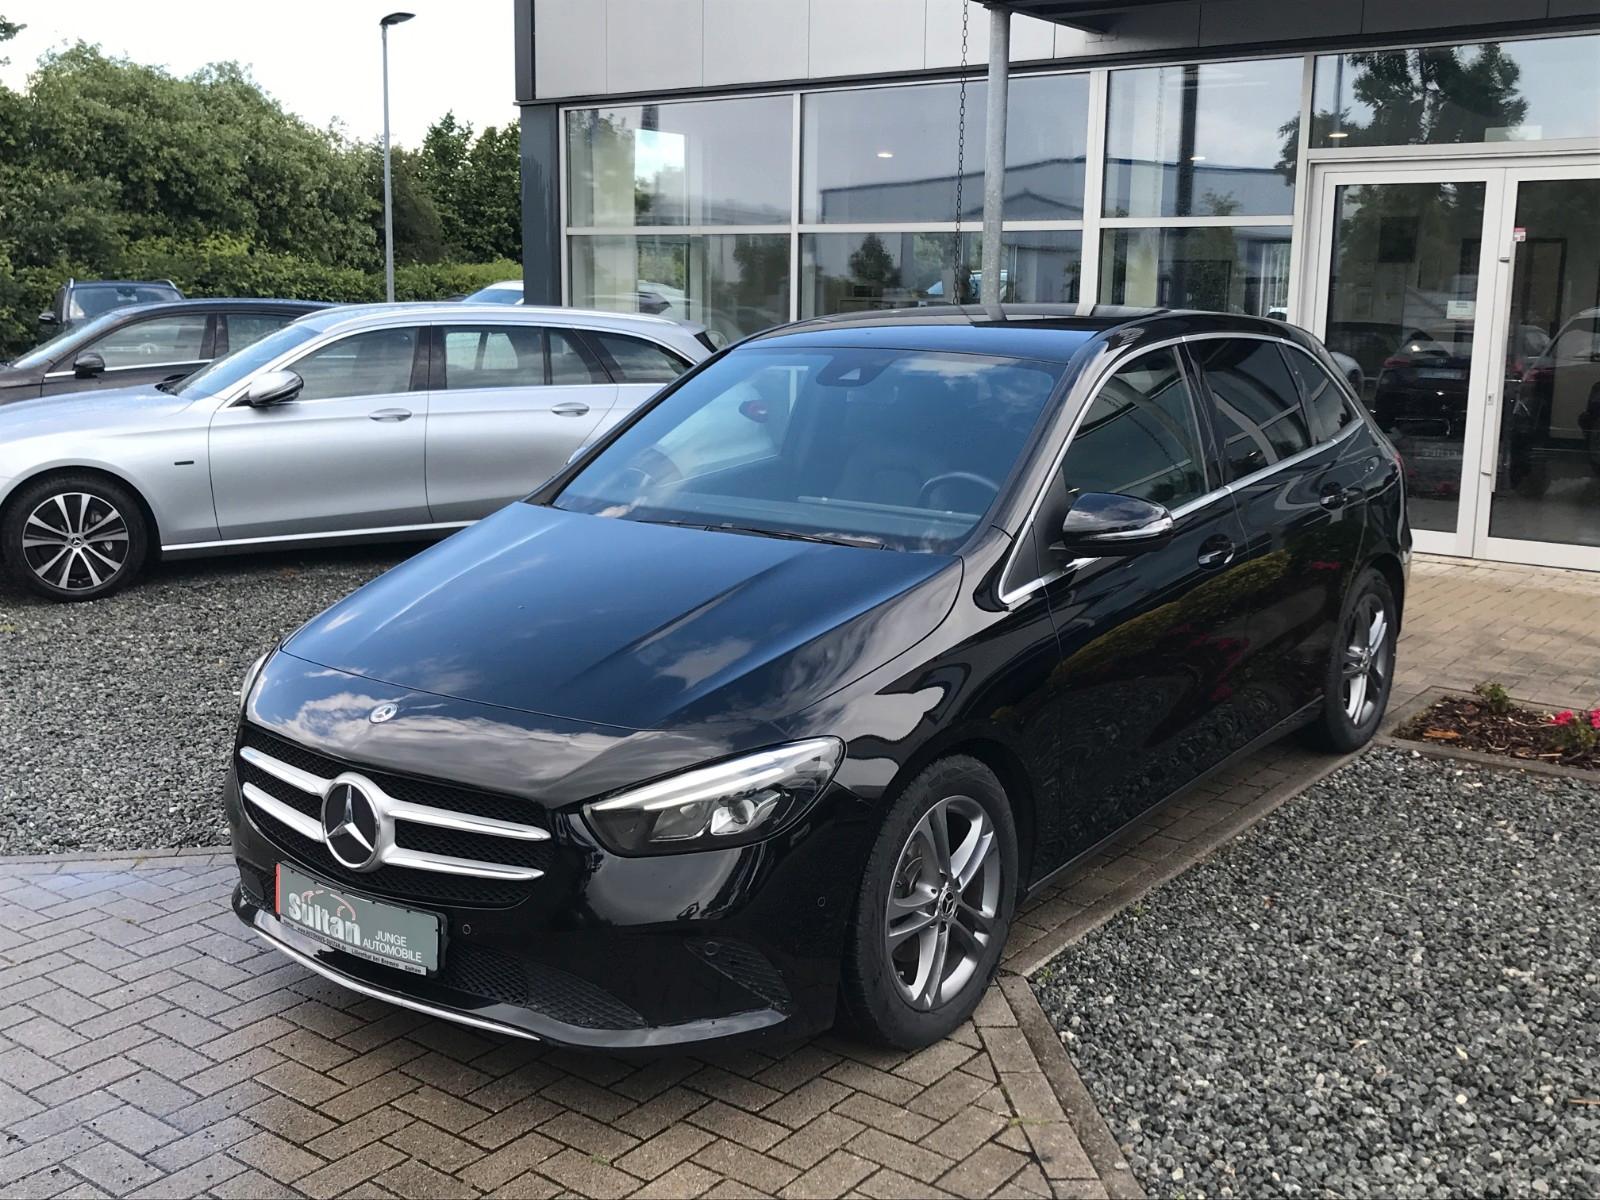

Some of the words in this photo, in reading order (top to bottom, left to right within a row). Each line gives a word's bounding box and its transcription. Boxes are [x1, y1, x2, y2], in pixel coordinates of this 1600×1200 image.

[288, 892, 361, 946] Sultan
[375, 930, 407, 947] JUNGE
[362, 937, 422, 963] AUTOMOBILE
[381, 957, 399, 967] Bremen
